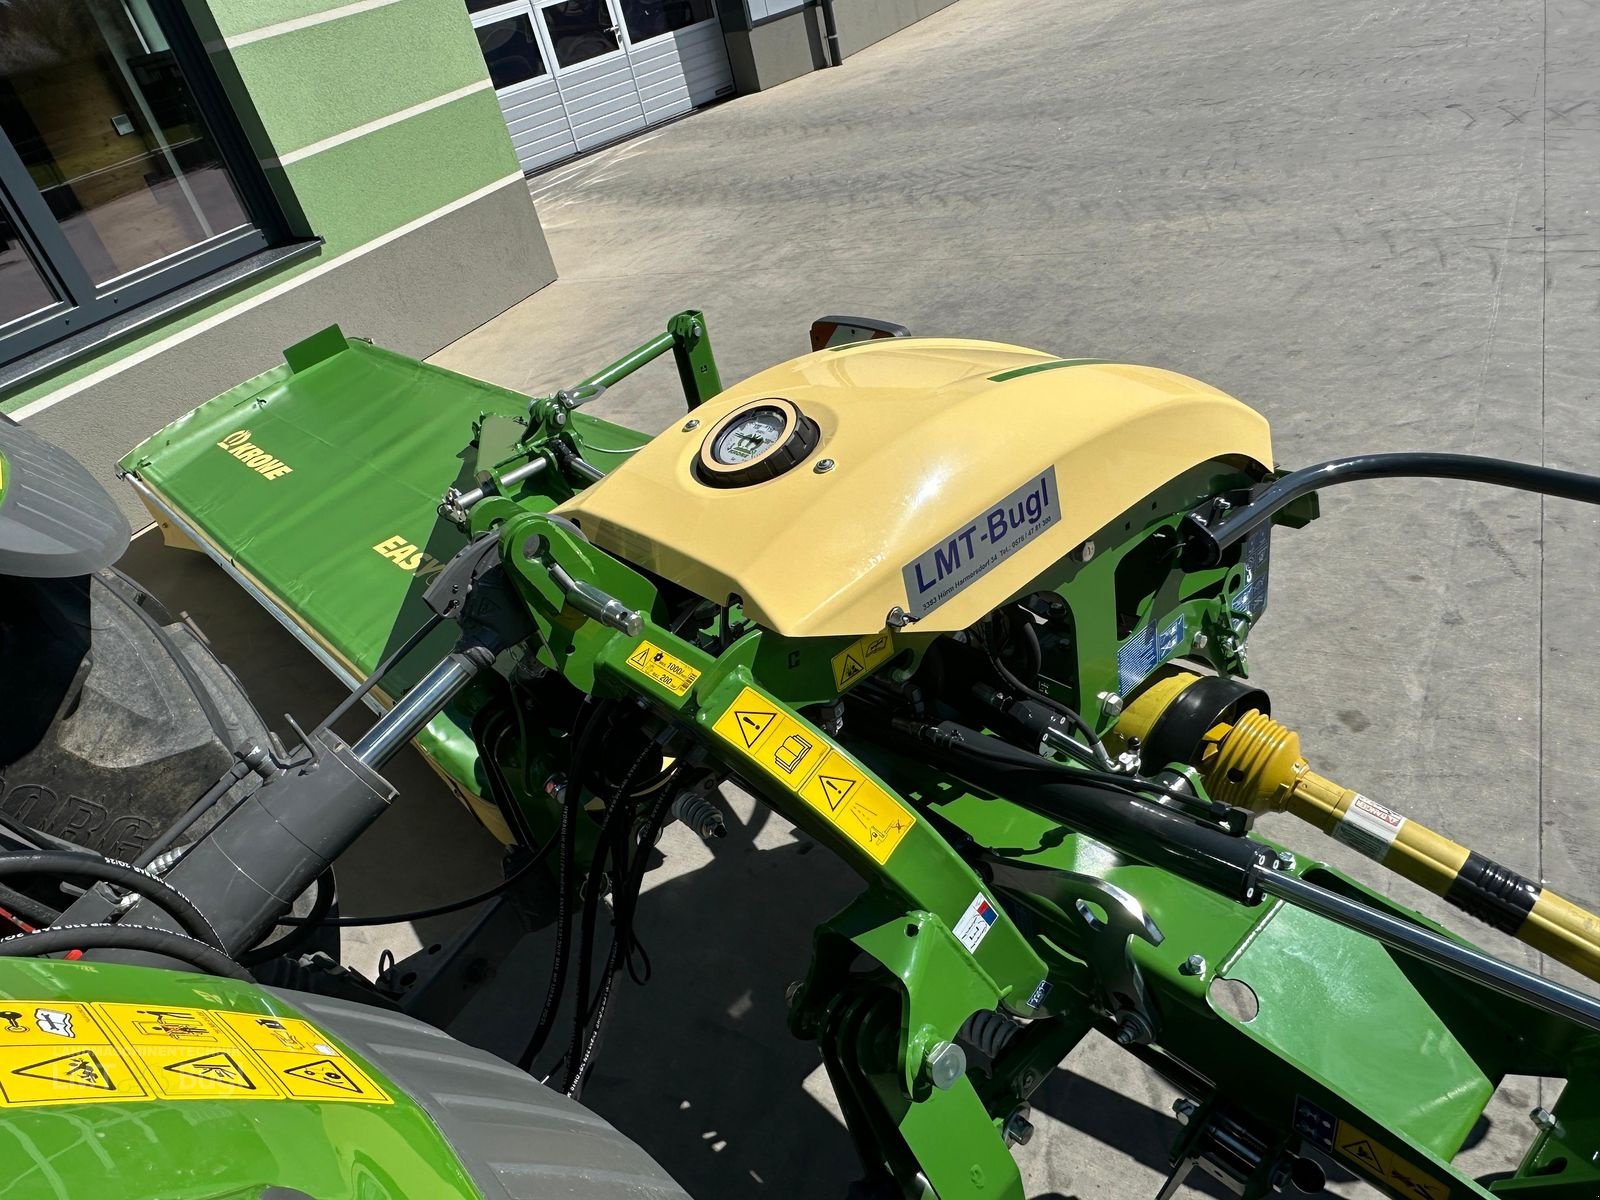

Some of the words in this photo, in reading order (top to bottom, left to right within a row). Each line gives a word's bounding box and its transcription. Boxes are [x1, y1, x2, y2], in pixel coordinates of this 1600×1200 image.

[228, 442, 294, 481] KRONE
[372, 535, 447, 585] EASY
[914, 477, 1049, 594] LMT-Bugl
[0, 775, 154, 864] ORG
